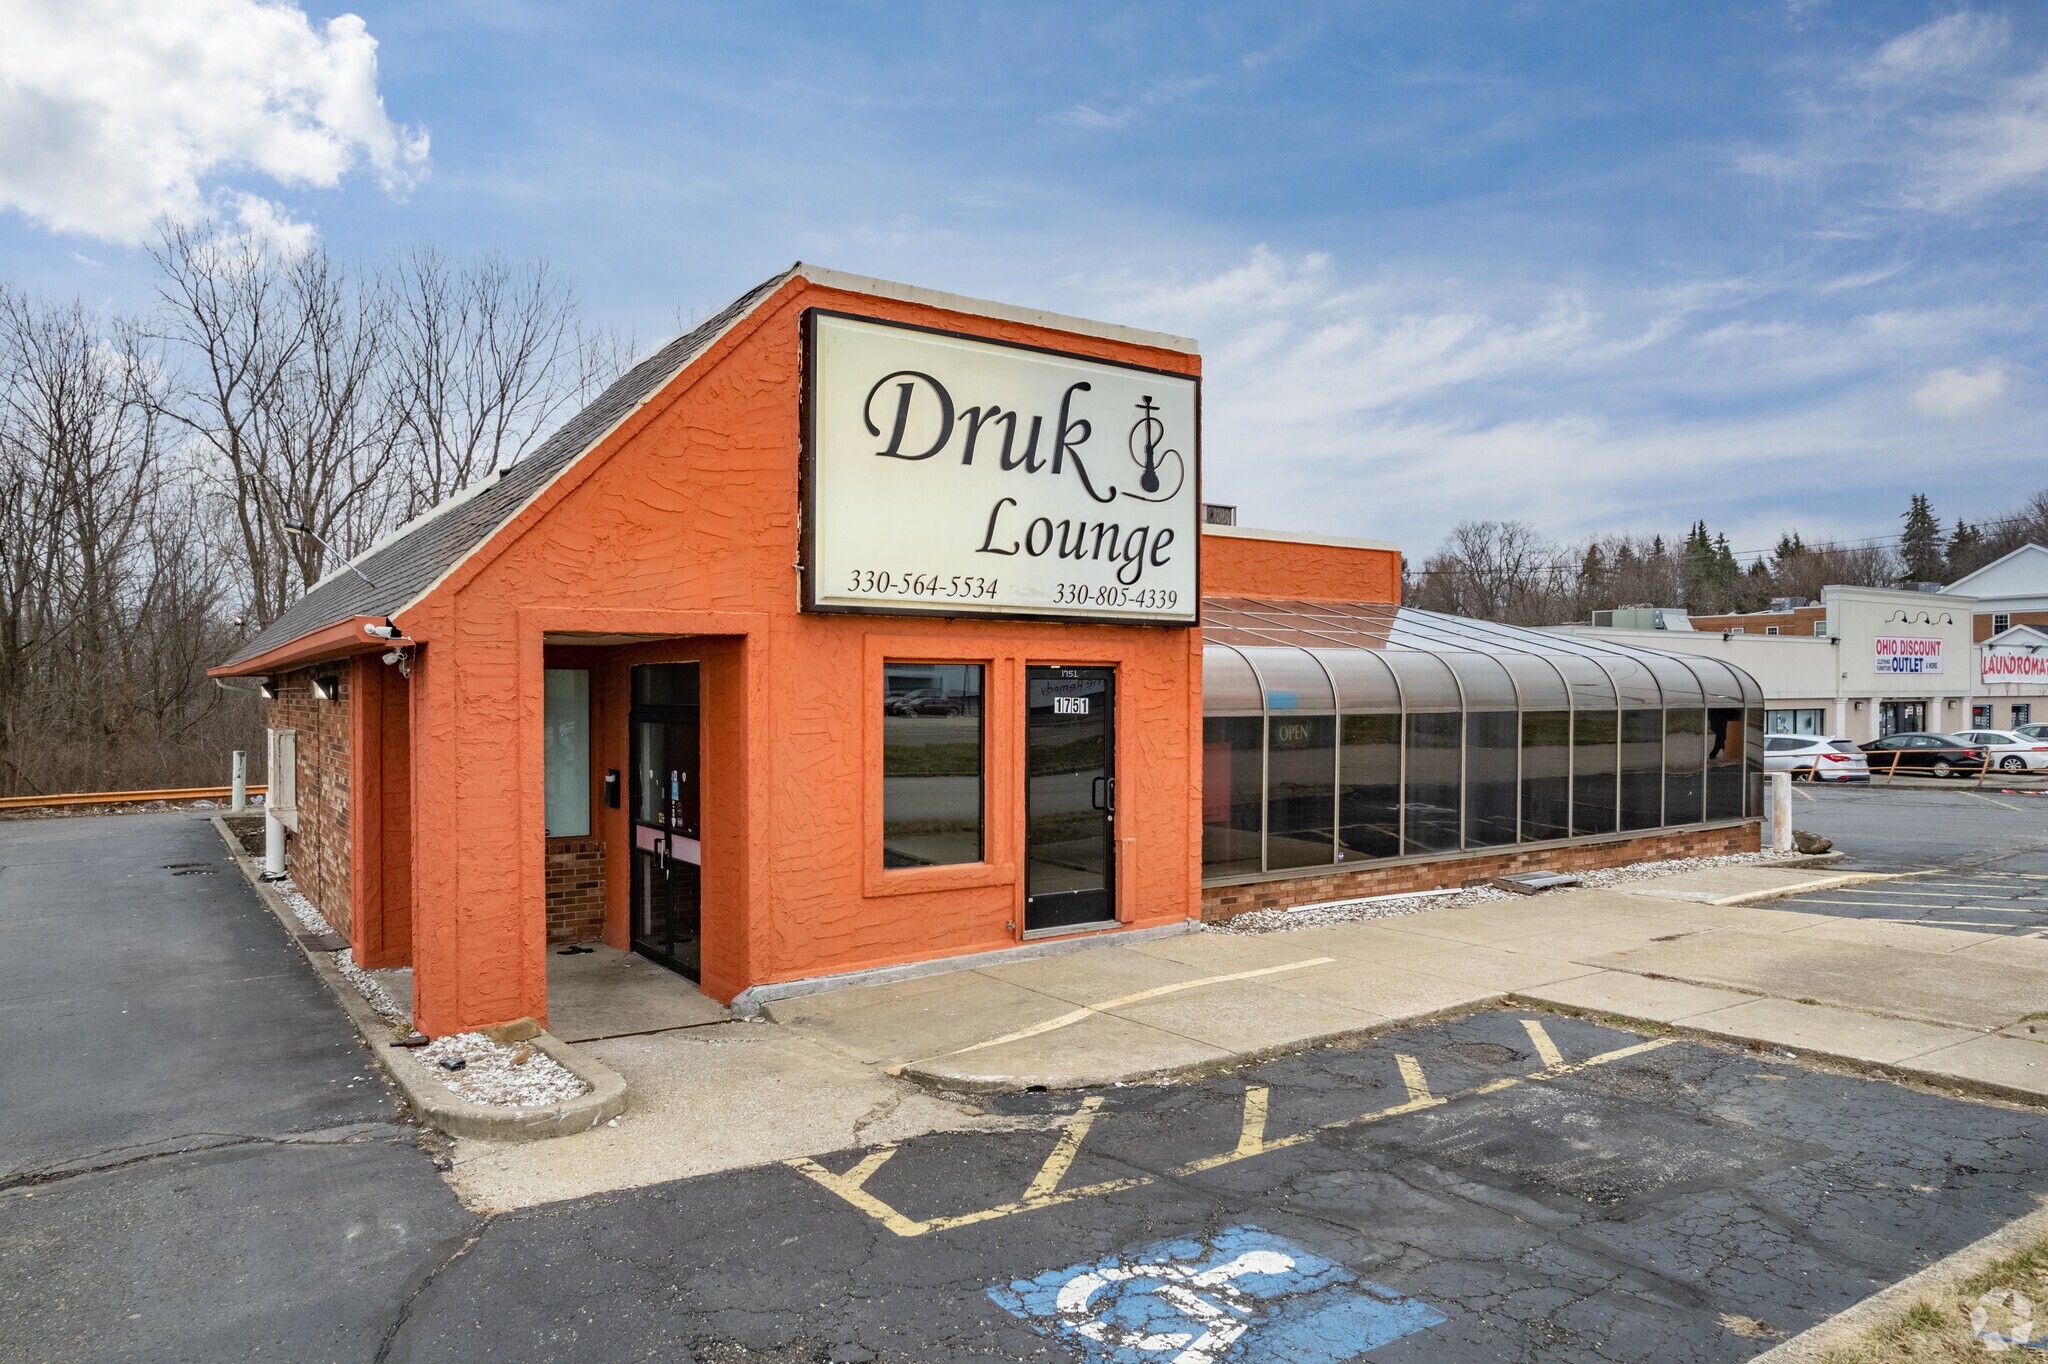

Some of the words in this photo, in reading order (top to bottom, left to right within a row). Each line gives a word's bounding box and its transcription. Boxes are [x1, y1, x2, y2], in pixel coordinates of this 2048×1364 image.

[863, 370, 1117, 504] Druk
[975, 497, 1175, 586] Lounge
[847, 569, 999, 600] 330-564-5534
[1053, 583, 1178, 610] 330-805-4339
[1876, 639, 1898, 655] OHIO
[1900, 640, 1941, 656] DISCOUNT
[1892, 657, 1924, 672] OUTLET
[1056, 697, 1087, 714] 1751
[1279, 724, 1308, 742] OPEN
